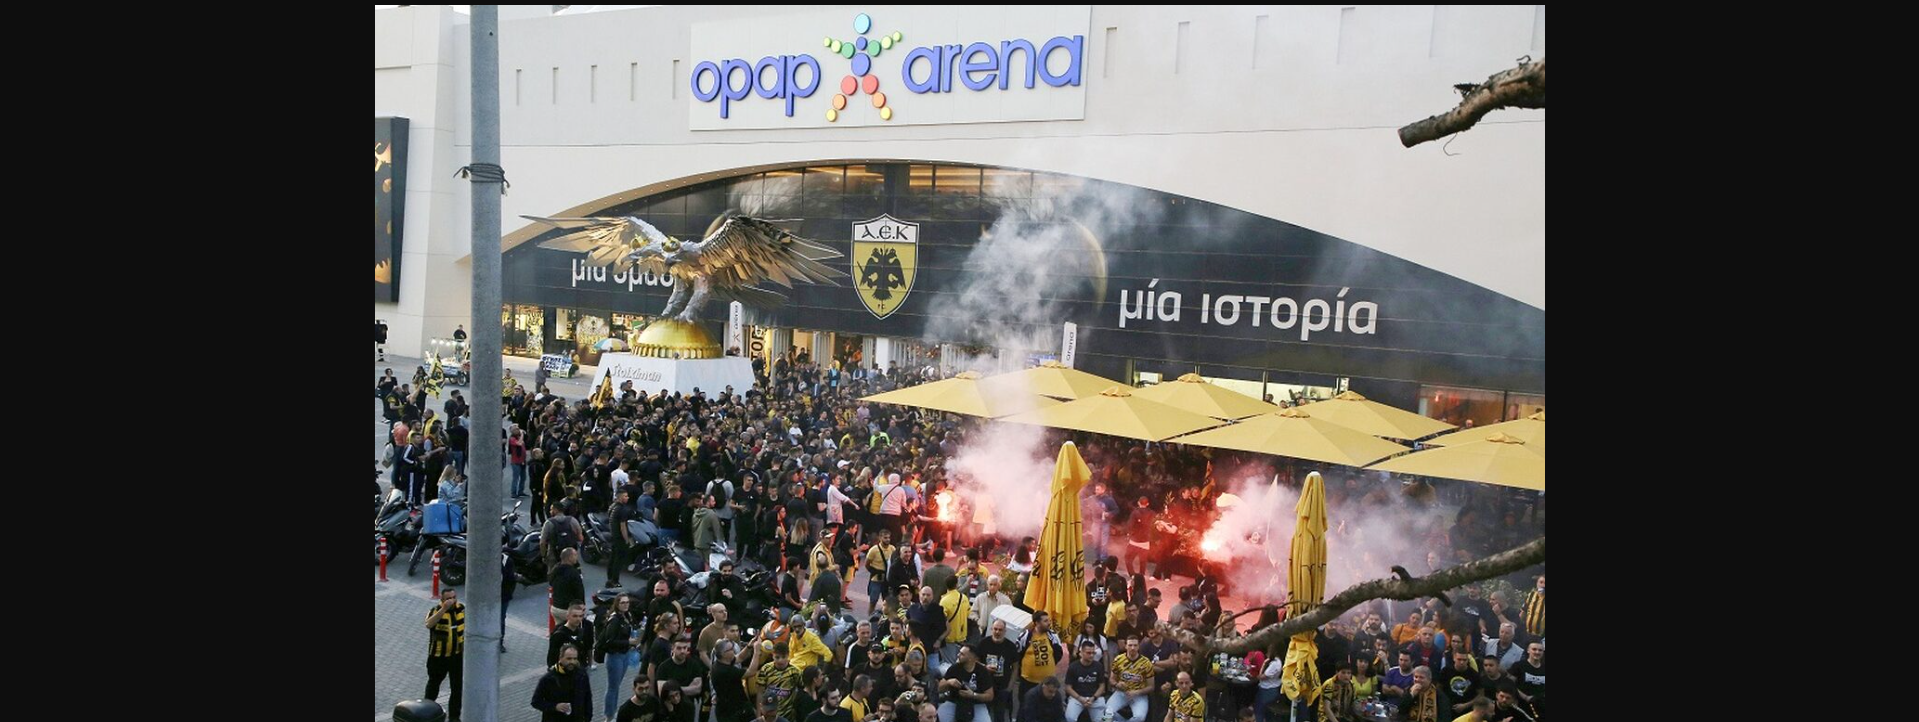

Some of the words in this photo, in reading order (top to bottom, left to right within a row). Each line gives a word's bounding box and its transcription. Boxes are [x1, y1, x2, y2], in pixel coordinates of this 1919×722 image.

[691, 53, 821, 119] opap
[902, 35, 1084, 94] arena
[1118, 278, 1182, 328] μία
[1201, 286, 1379, 342] ιστορία
[1066, 331, 1074, 361] arena
